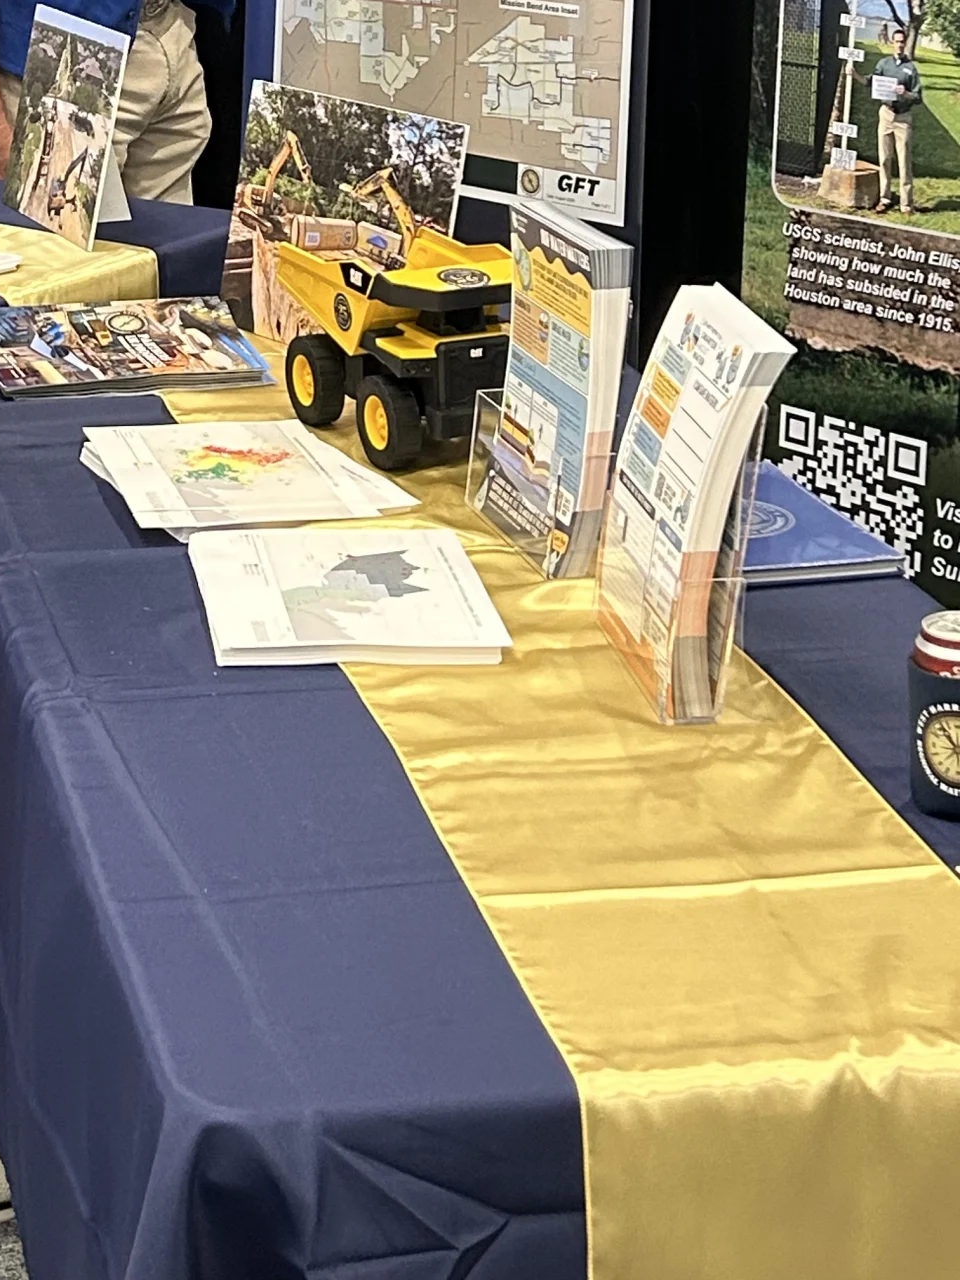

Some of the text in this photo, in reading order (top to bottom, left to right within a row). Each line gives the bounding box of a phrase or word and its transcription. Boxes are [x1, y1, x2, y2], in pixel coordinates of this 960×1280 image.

[544, 4, 559, 13] Area
[557, 174, 600, 197] GFT
[782, 222, 822, 243] USGS
[824, 233, 885, 257] scientist,
[889, 244, 925, 263] John
[786, 263, 954, 311] land has subsided in the
[792, 245, 951, 290] showing how much the
[783, 282, 955, 333] Houston area since 1915.
[933, 528, 954, 549] to
